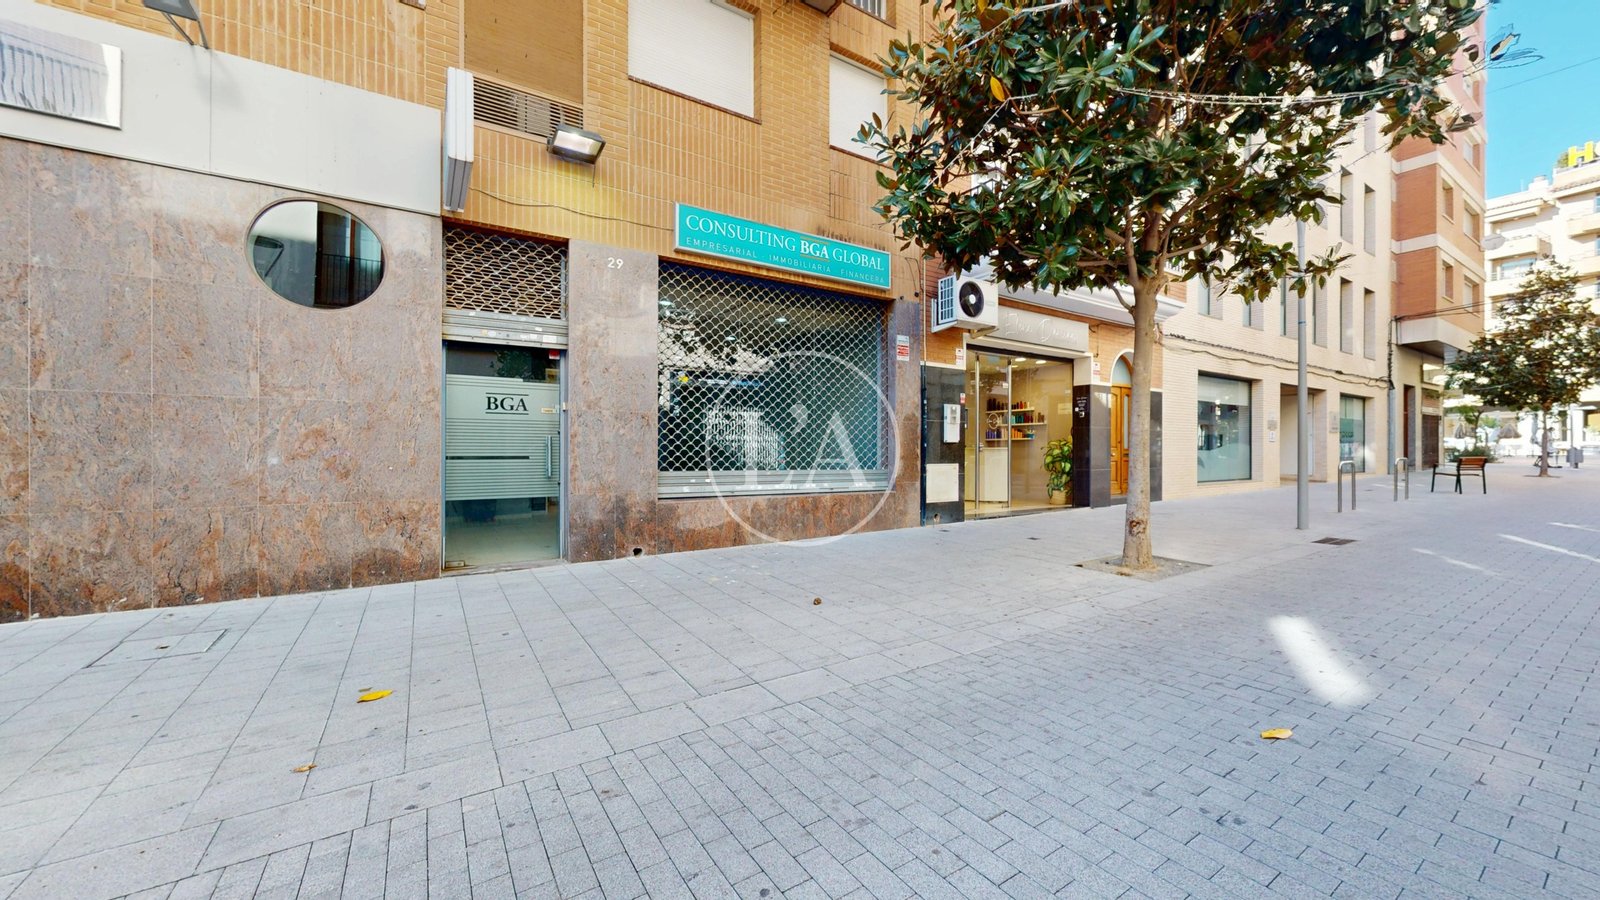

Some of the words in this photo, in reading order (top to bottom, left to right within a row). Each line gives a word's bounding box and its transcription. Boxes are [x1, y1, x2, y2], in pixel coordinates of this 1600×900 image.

[686, 214, 796, 252] CONSULTING
[800, 240, 829, 259] BGA
[832, 248, 885, 271] GLOBAL
[607, 256, 624, 269] 29
[686, 237, 757, 258] EMPRESARIAL
[840, 269, 884, 283] FINANCERA
[486, 396, 528, 411] BGA
